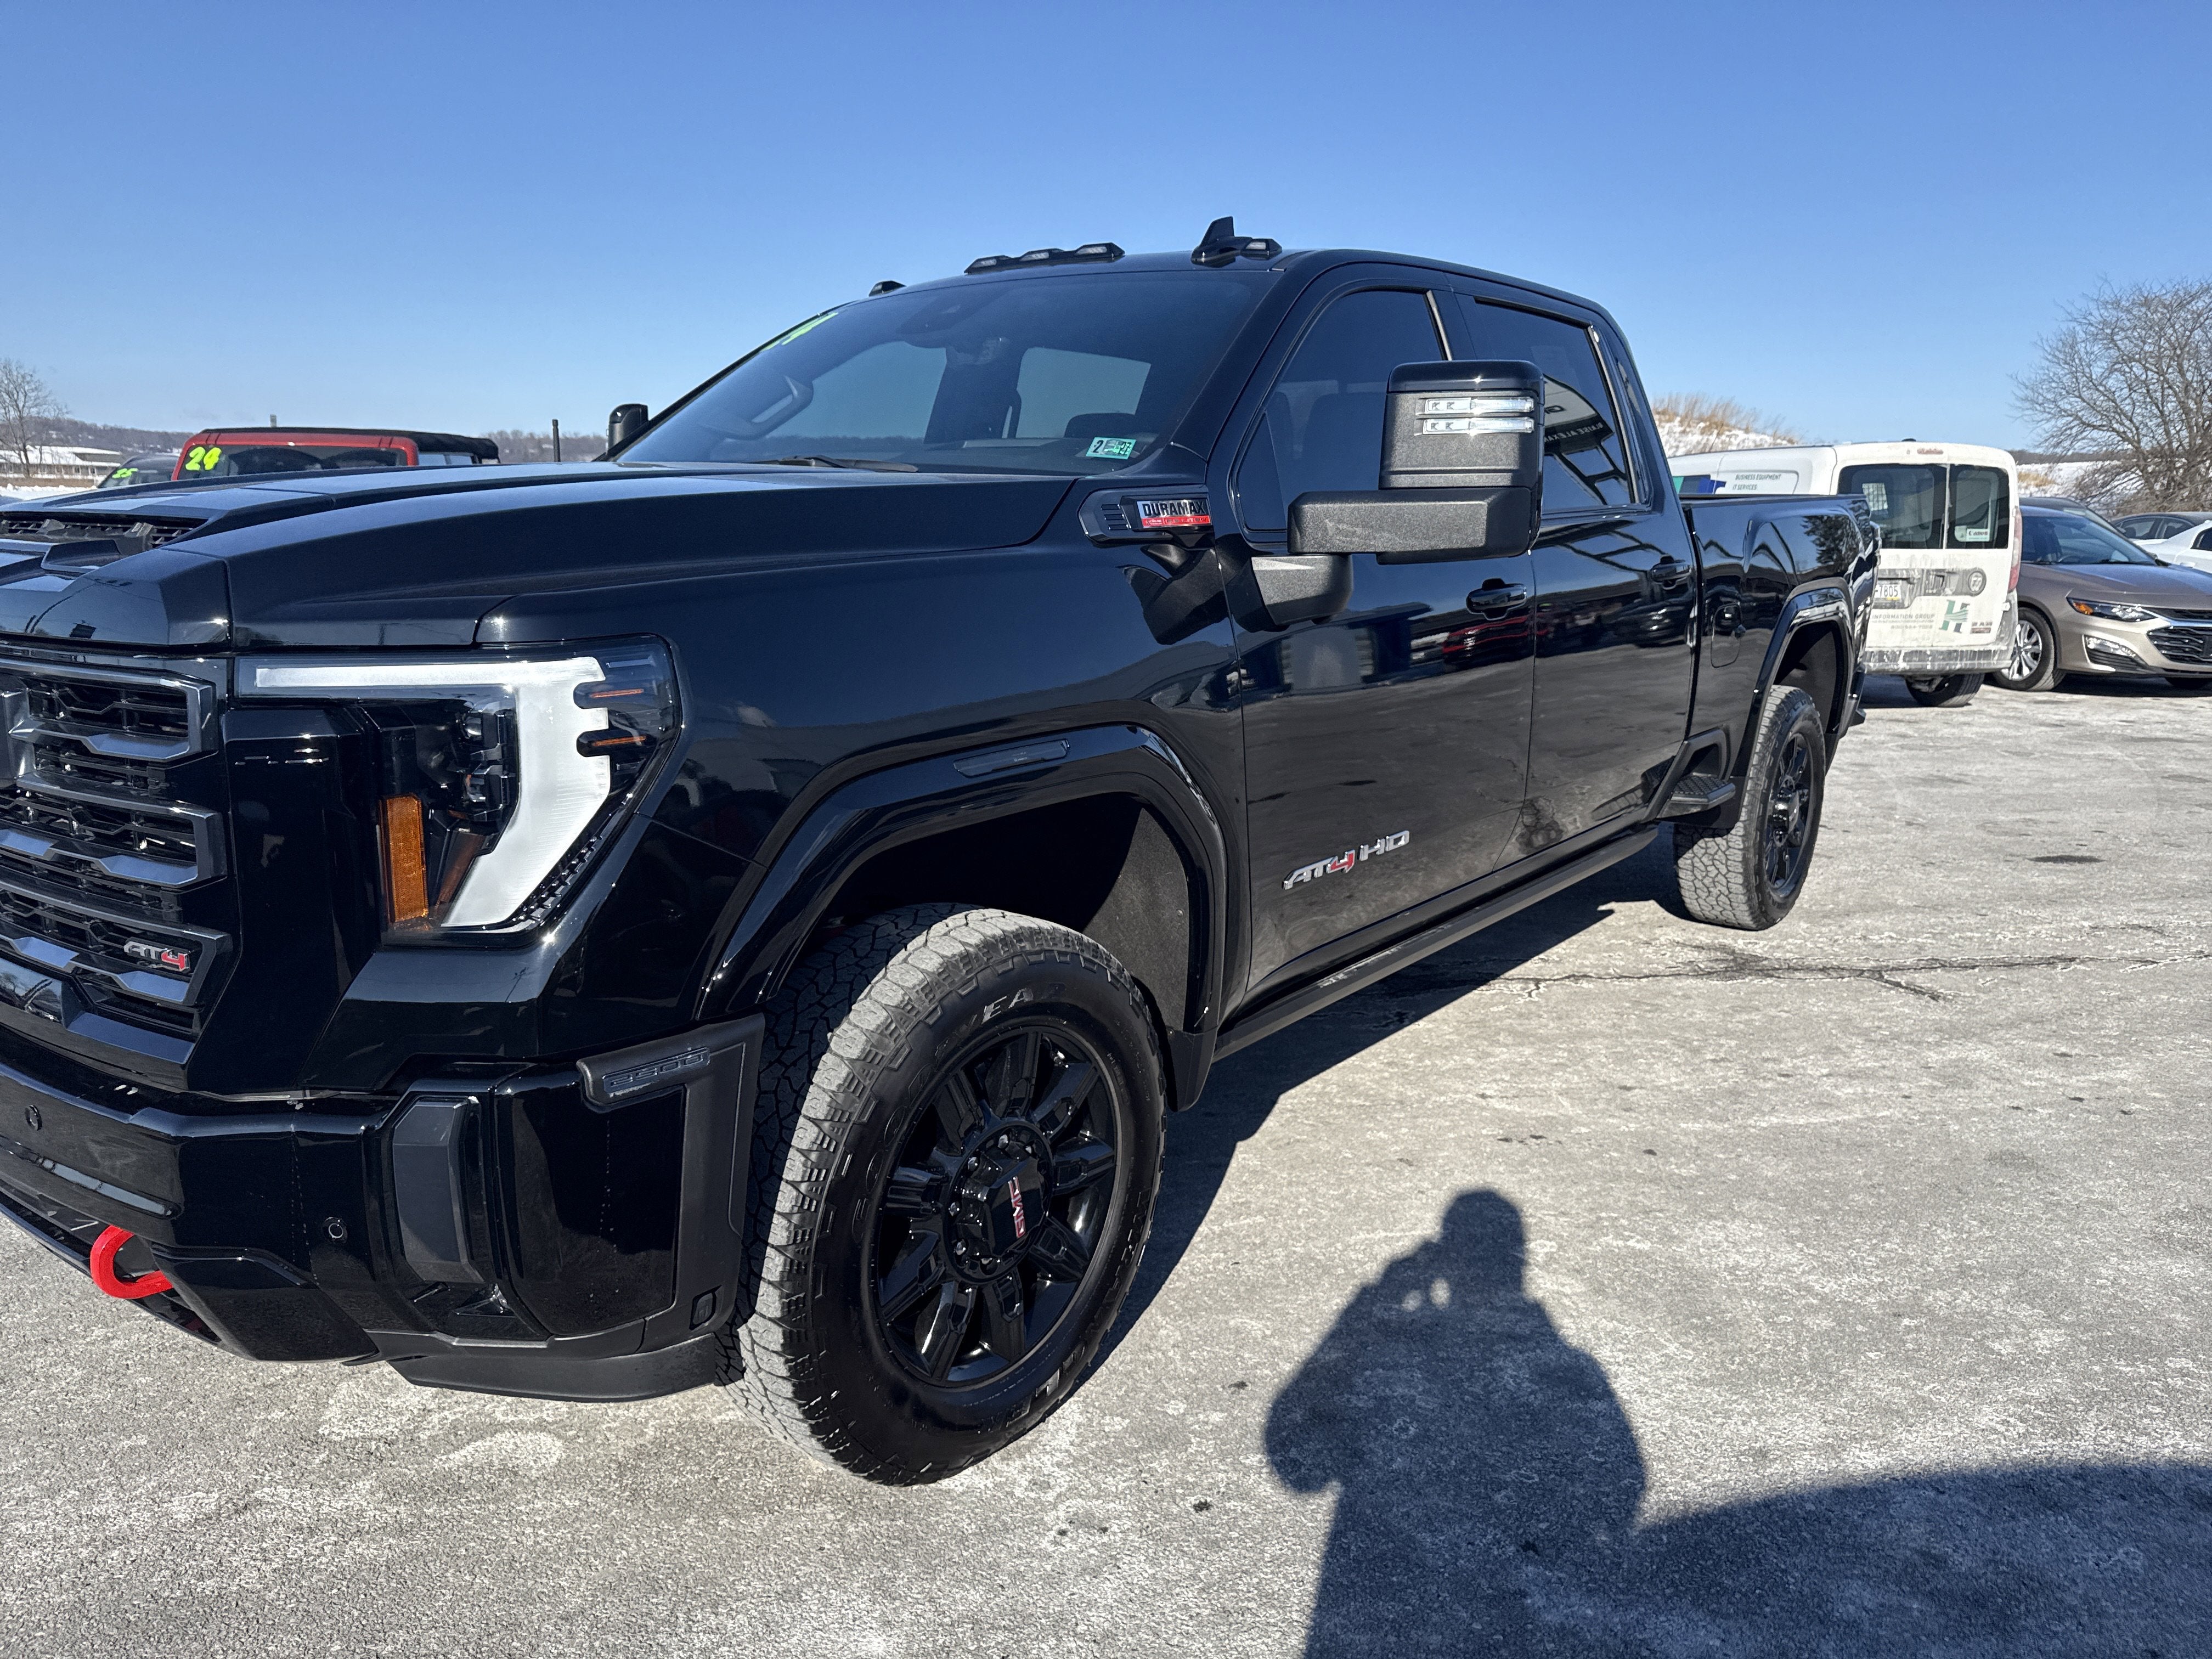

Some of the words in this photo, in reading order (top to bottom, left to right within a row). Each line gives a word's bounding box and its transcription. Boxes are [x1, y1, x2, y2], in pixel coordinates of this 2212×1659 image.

[185, 446, 222, 471] 24
[1092, 439, 1104, 454] 2
[1142, 501, 1206, 516] DURAMAX
[1282, 849, 1356, 890] AT4
[1359, 830, 1410, 861] HD
[123, 940, 190, 972] AT4
[1007, 1176, 1026, 1238] GMC
